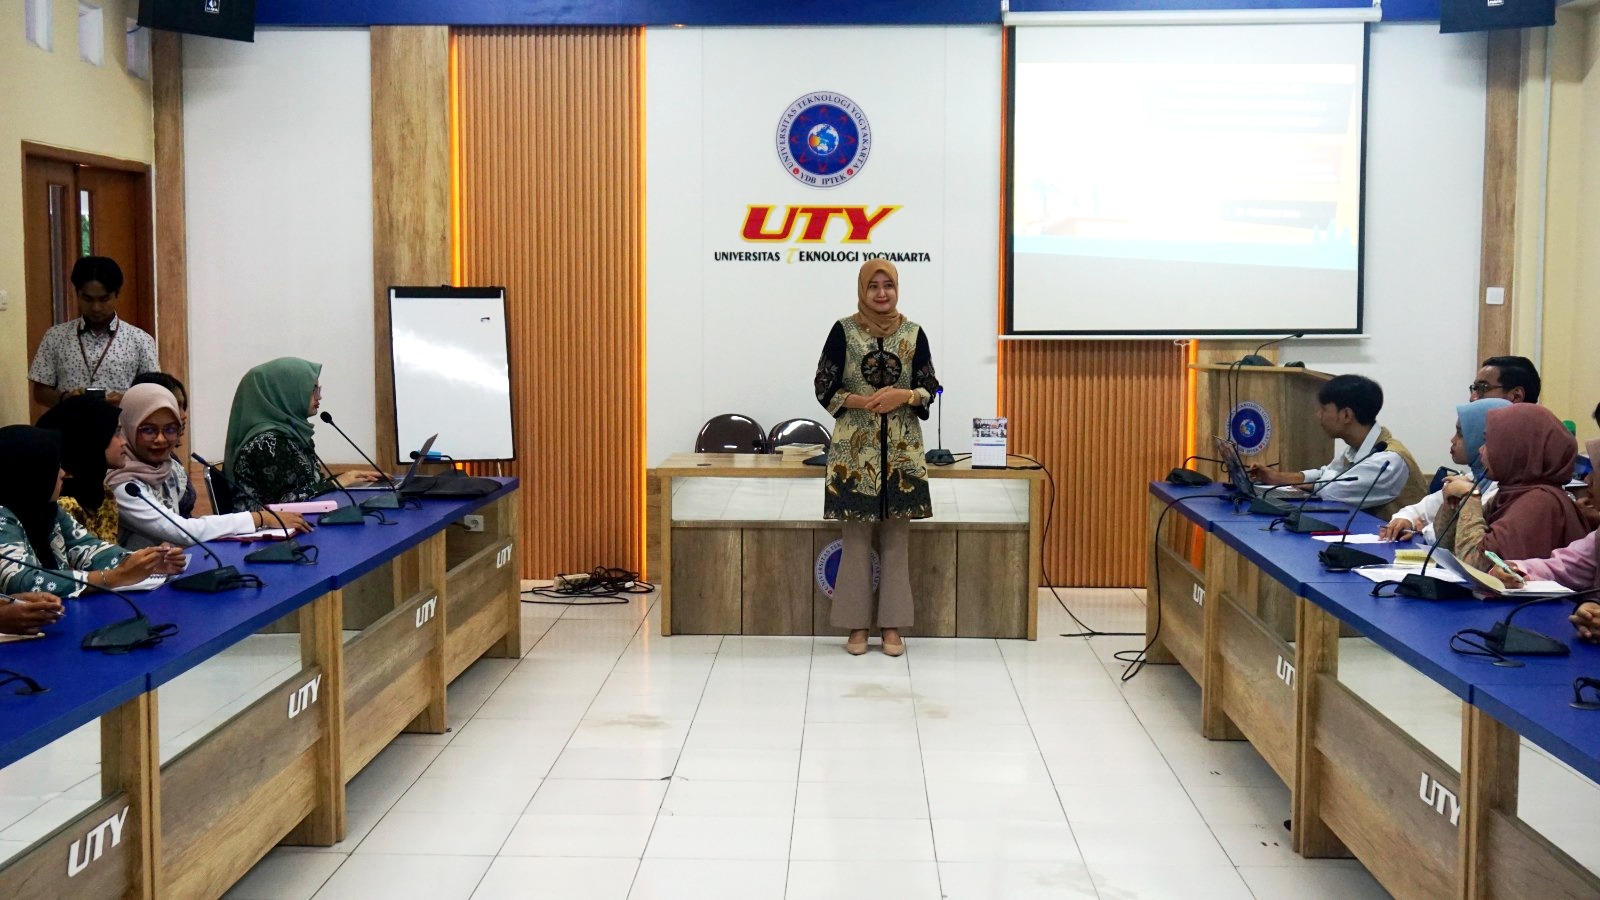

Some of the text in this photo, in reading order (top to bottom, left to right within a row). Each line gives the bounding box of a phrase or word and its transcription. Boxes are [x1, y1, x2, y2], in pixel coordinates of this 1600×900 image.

[779, 94, 869, 169] UNIVERSITAS TEKNOLOGI YOGYAKARTA
[800, 172, 847, 185] YDB IPTEK
[741, 204, 903, 243] UTY
[714, 251, 781, 262] UNIVERSITAS
[496, 543, 513, 569] UTY
[415, 595, 438, 628] UTY
[1193, 583, 1206, 607] UT
[288, 673, 322, 719] UTY
[1419, 771, 1460, 827] UTY
[67, 804, 130, 878] UTY
